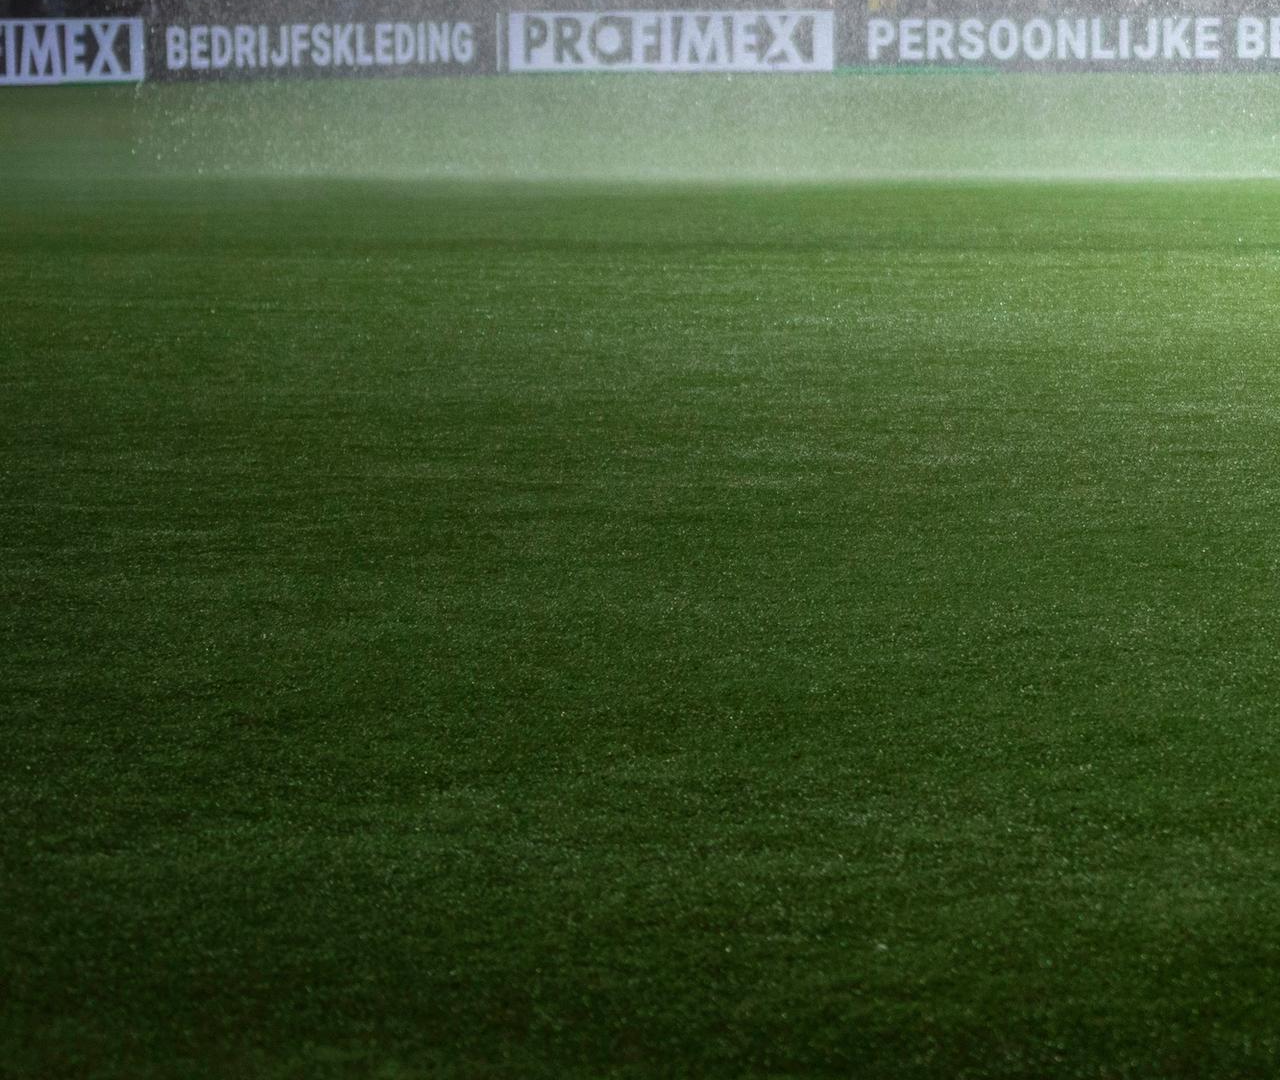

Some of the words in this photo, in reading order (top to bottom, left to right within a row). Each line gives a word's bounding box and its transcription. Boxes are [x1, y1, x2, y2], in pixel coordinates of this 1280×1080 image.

[0, 22, 120, 78] IMEX
[166, 21, 474, 70] BEDRIJFSKLEDING
[523, 14, 804, 66] PROFIMEX
[867, 16, 1221, 61] PERSOONLIJKE
